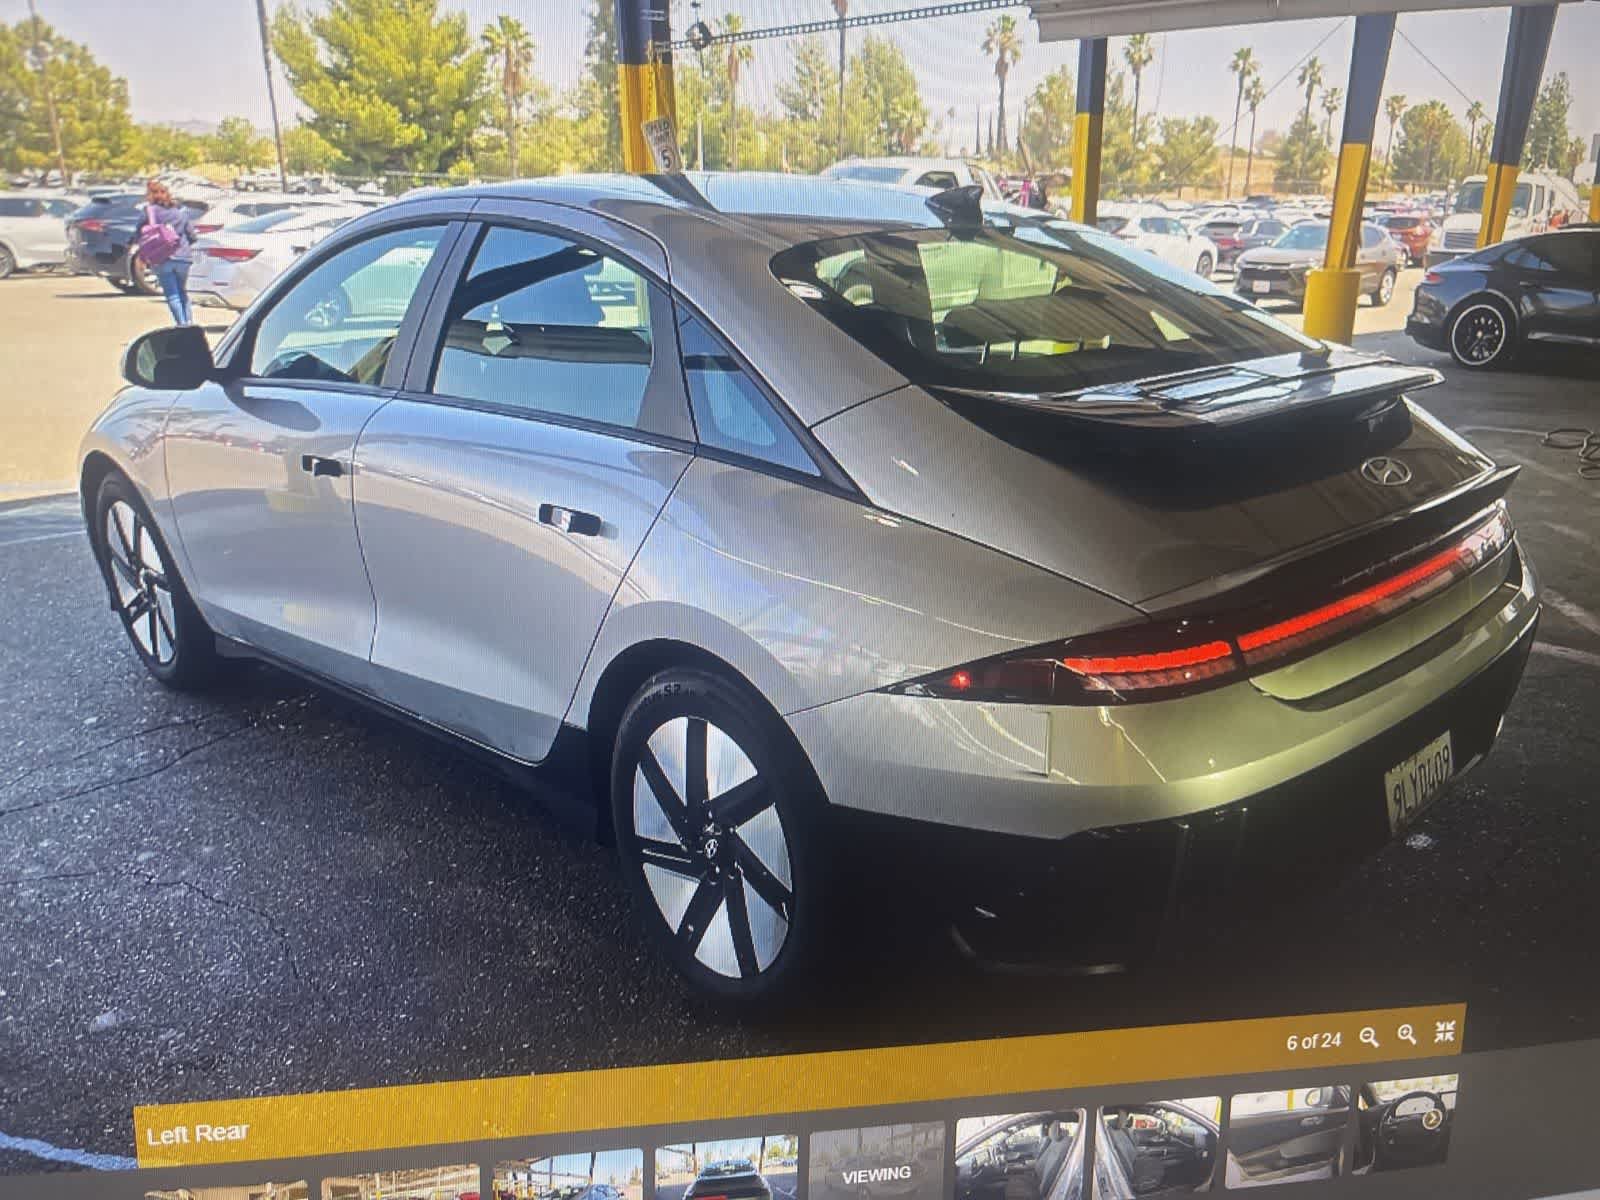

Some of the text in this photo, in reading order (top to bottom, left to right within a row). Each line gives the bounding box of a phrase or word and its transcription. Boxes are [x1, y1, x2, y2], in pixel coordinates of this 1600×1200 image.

[1286, 1032, 1342, 1050] 6 of 24
[147, 1124, 250, 1146] Left Rear
[842, 1165, 911, 1185] VIEWING
